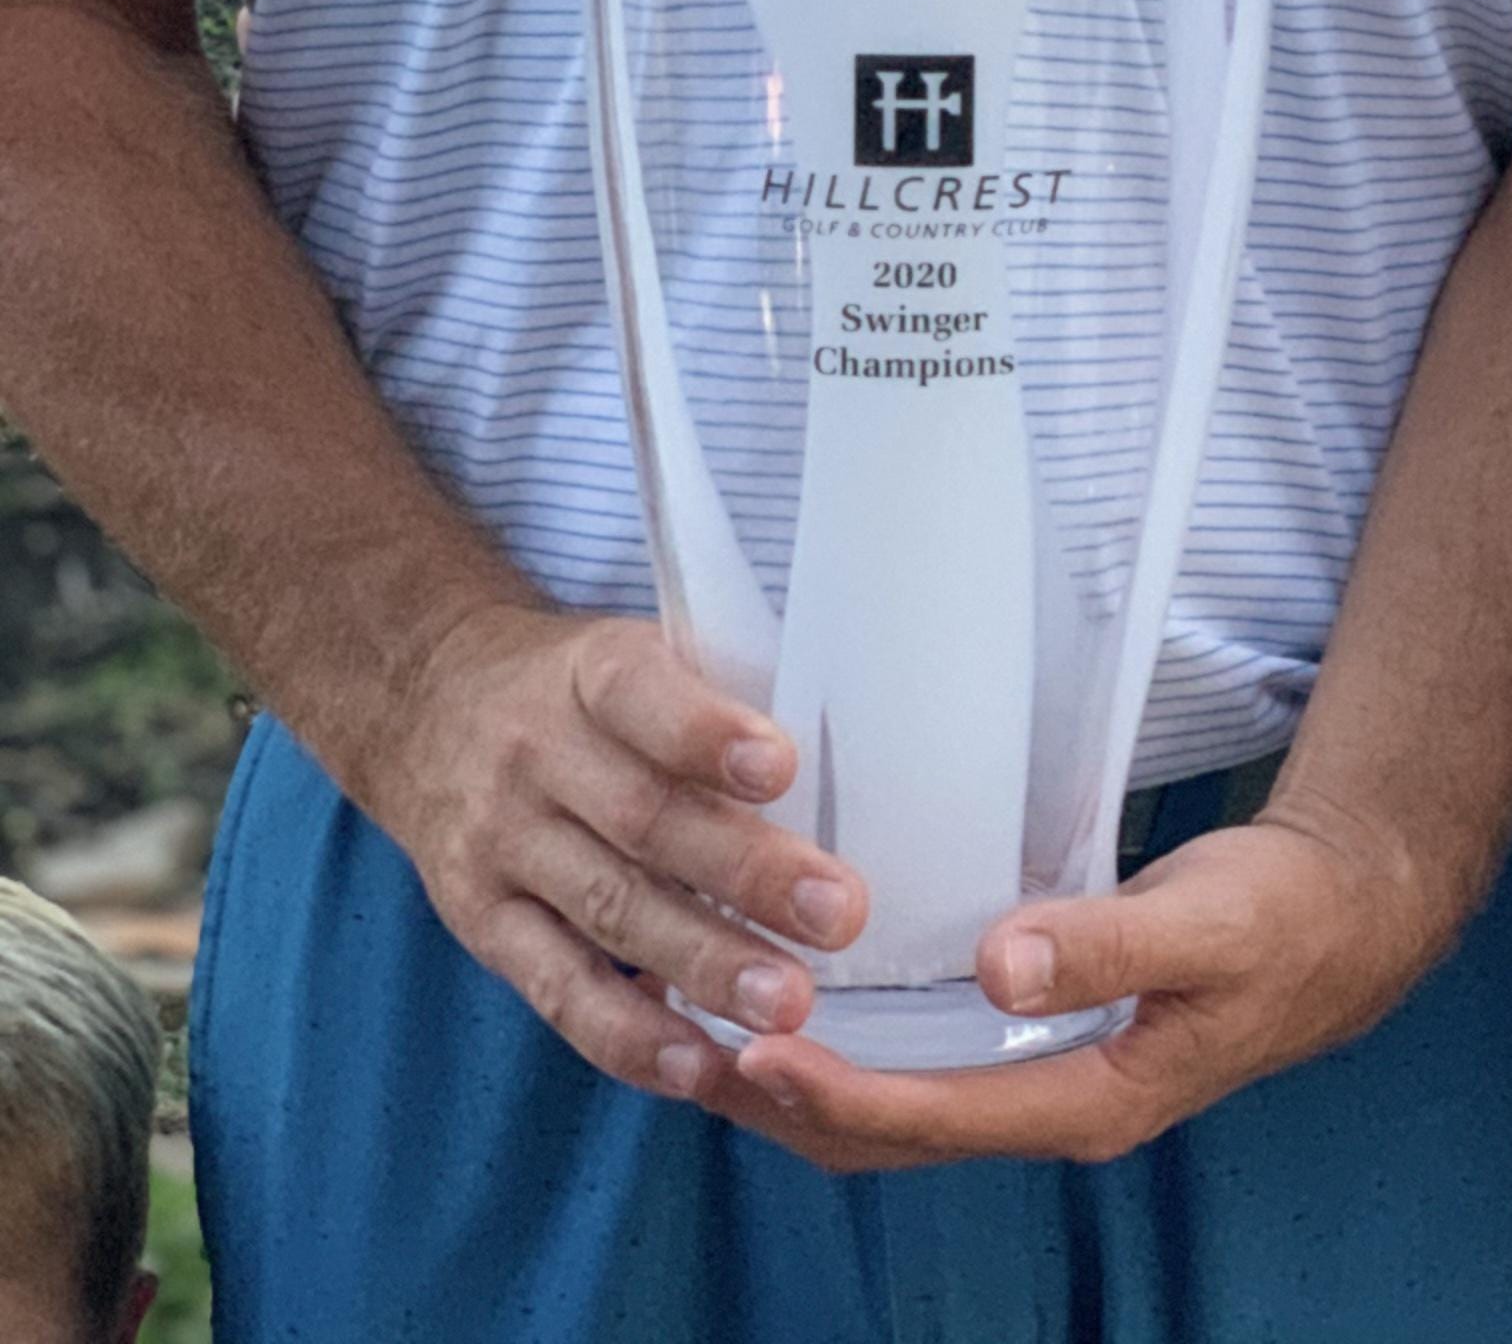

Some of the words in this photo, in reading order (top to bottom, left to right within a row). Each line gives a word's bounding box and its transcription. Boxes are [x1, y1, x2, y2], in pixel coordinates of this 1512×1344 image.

[761, 168, 1073, 213] HILLCREST
[782, 217, 840, 236] GOLF
[848, 220, 861, 238] &
[870, 221, 984, 240] COUNTRY
[991, 217, 1050, 237] CLUB
[872, 261, 958, 289] 2020
[840, 303, 989, 342] Swinger
[812, 345, 1016, 387] Champions
